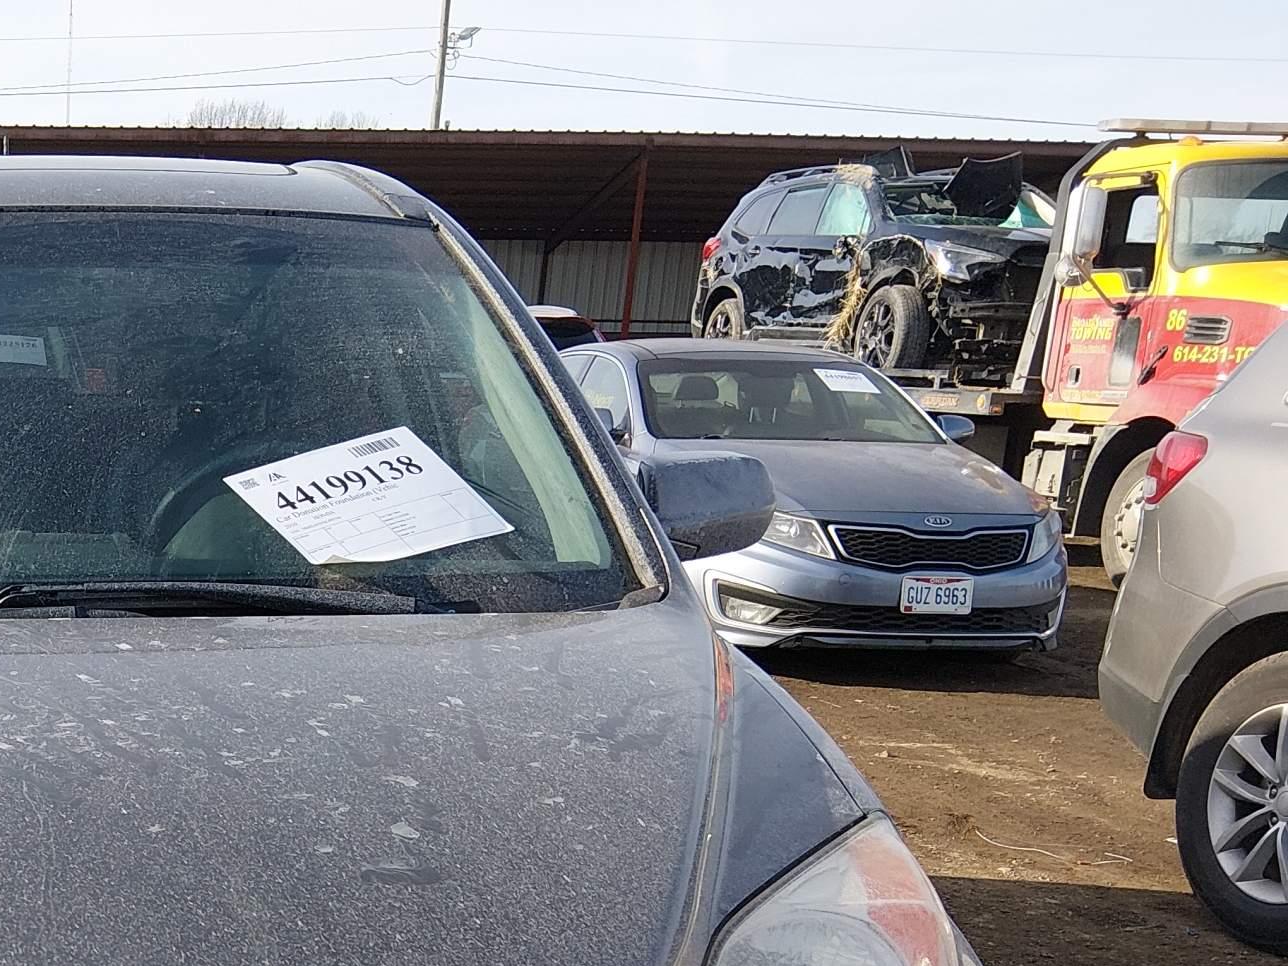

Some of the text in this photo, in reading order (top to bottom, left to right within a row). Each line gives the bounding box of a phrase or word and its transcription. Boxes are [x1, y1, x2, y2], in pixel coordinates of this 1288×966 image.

[1166, 308, 1187, 331] 86
[1071, 327, 1113, 340] TOWING
[277, 455, 423, 510] 44199138
[276, 513, 292, 523] Car
[907, 586, 968, 606] GUZ 6963
